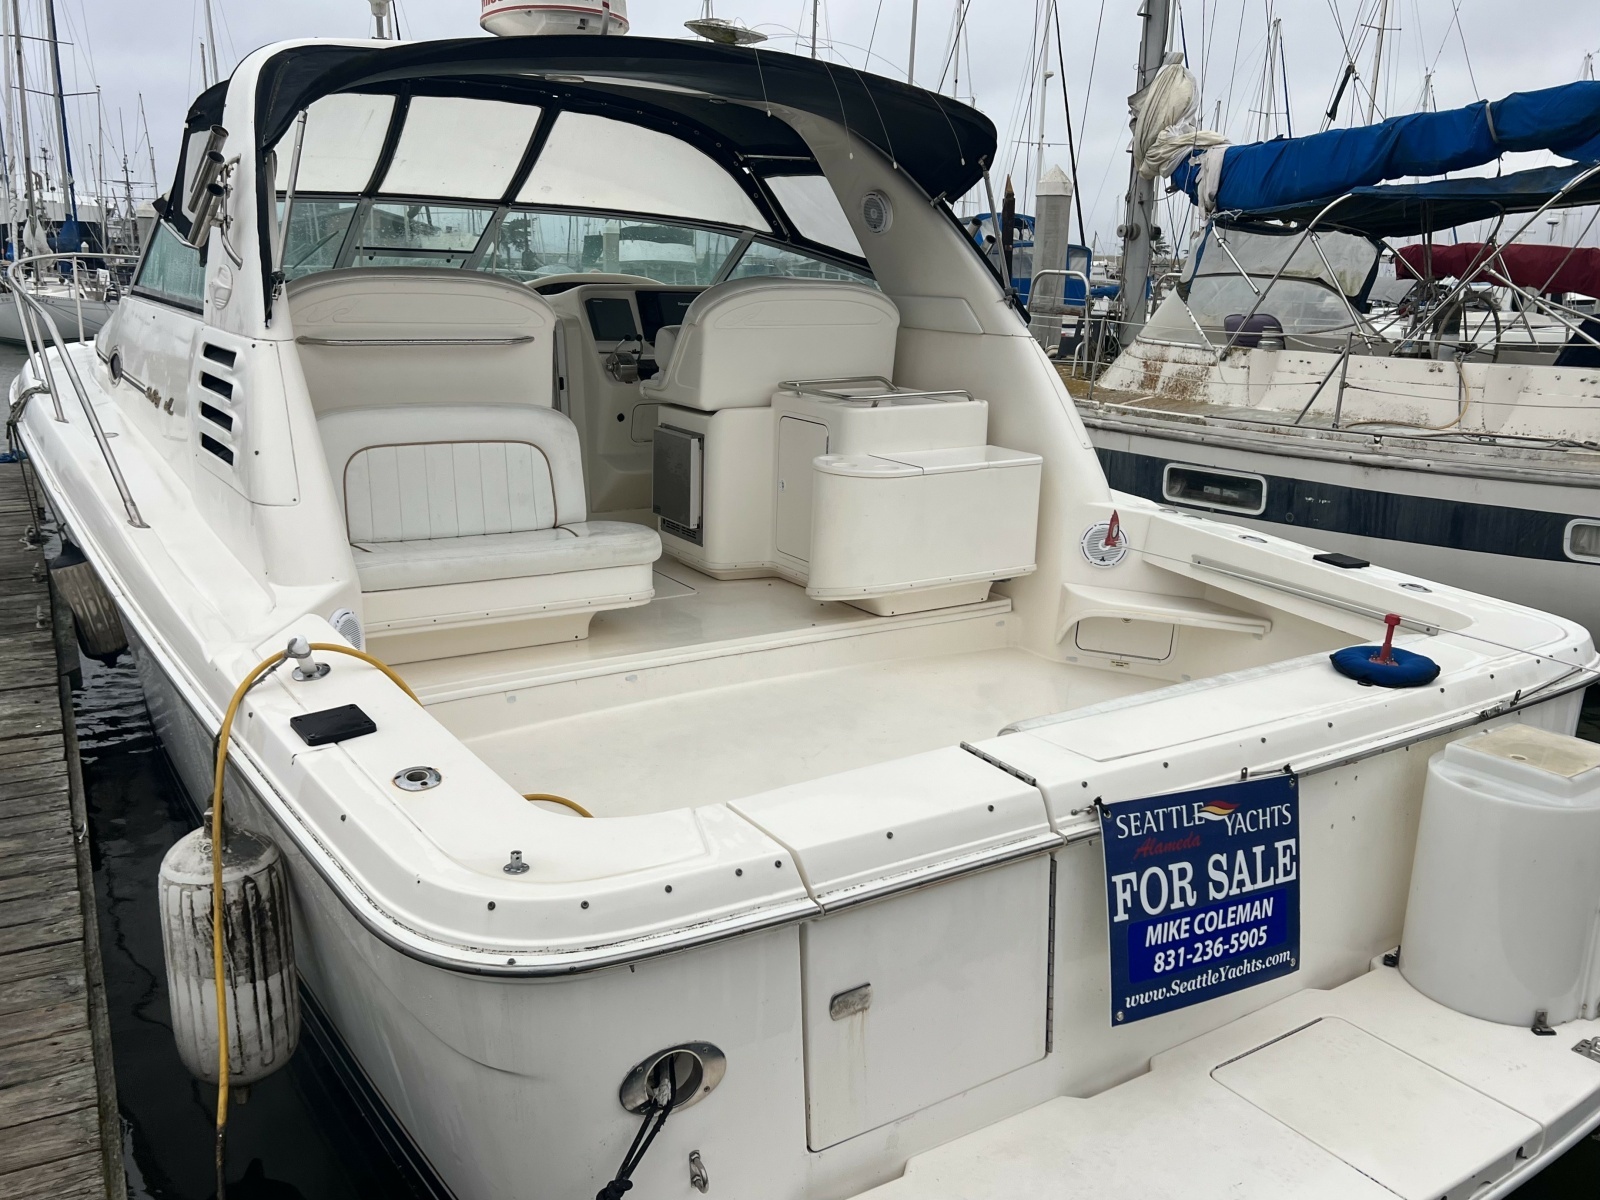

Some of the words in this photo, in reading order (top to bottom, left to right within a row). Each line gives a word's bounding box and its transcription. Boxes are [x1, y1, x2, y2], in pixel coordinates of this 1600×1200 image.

[1115, 802, 1206, 839] SEATTLE
[1224, 803, 1292, 836] YACHTS
[1132, 831, 1202, 861] Alameda
[1111, 861, 1198, 923] FOR
[1207, 838, 1297, 901] SALE
[1145, 917, 1191, 948] MIKE
[1193, 897, 1274, 936] COLEMAN
[1153, 925, 1268, 974] 831-236-5905
[1125, 950, 1291, 1009] www.SeattleYachts.com
